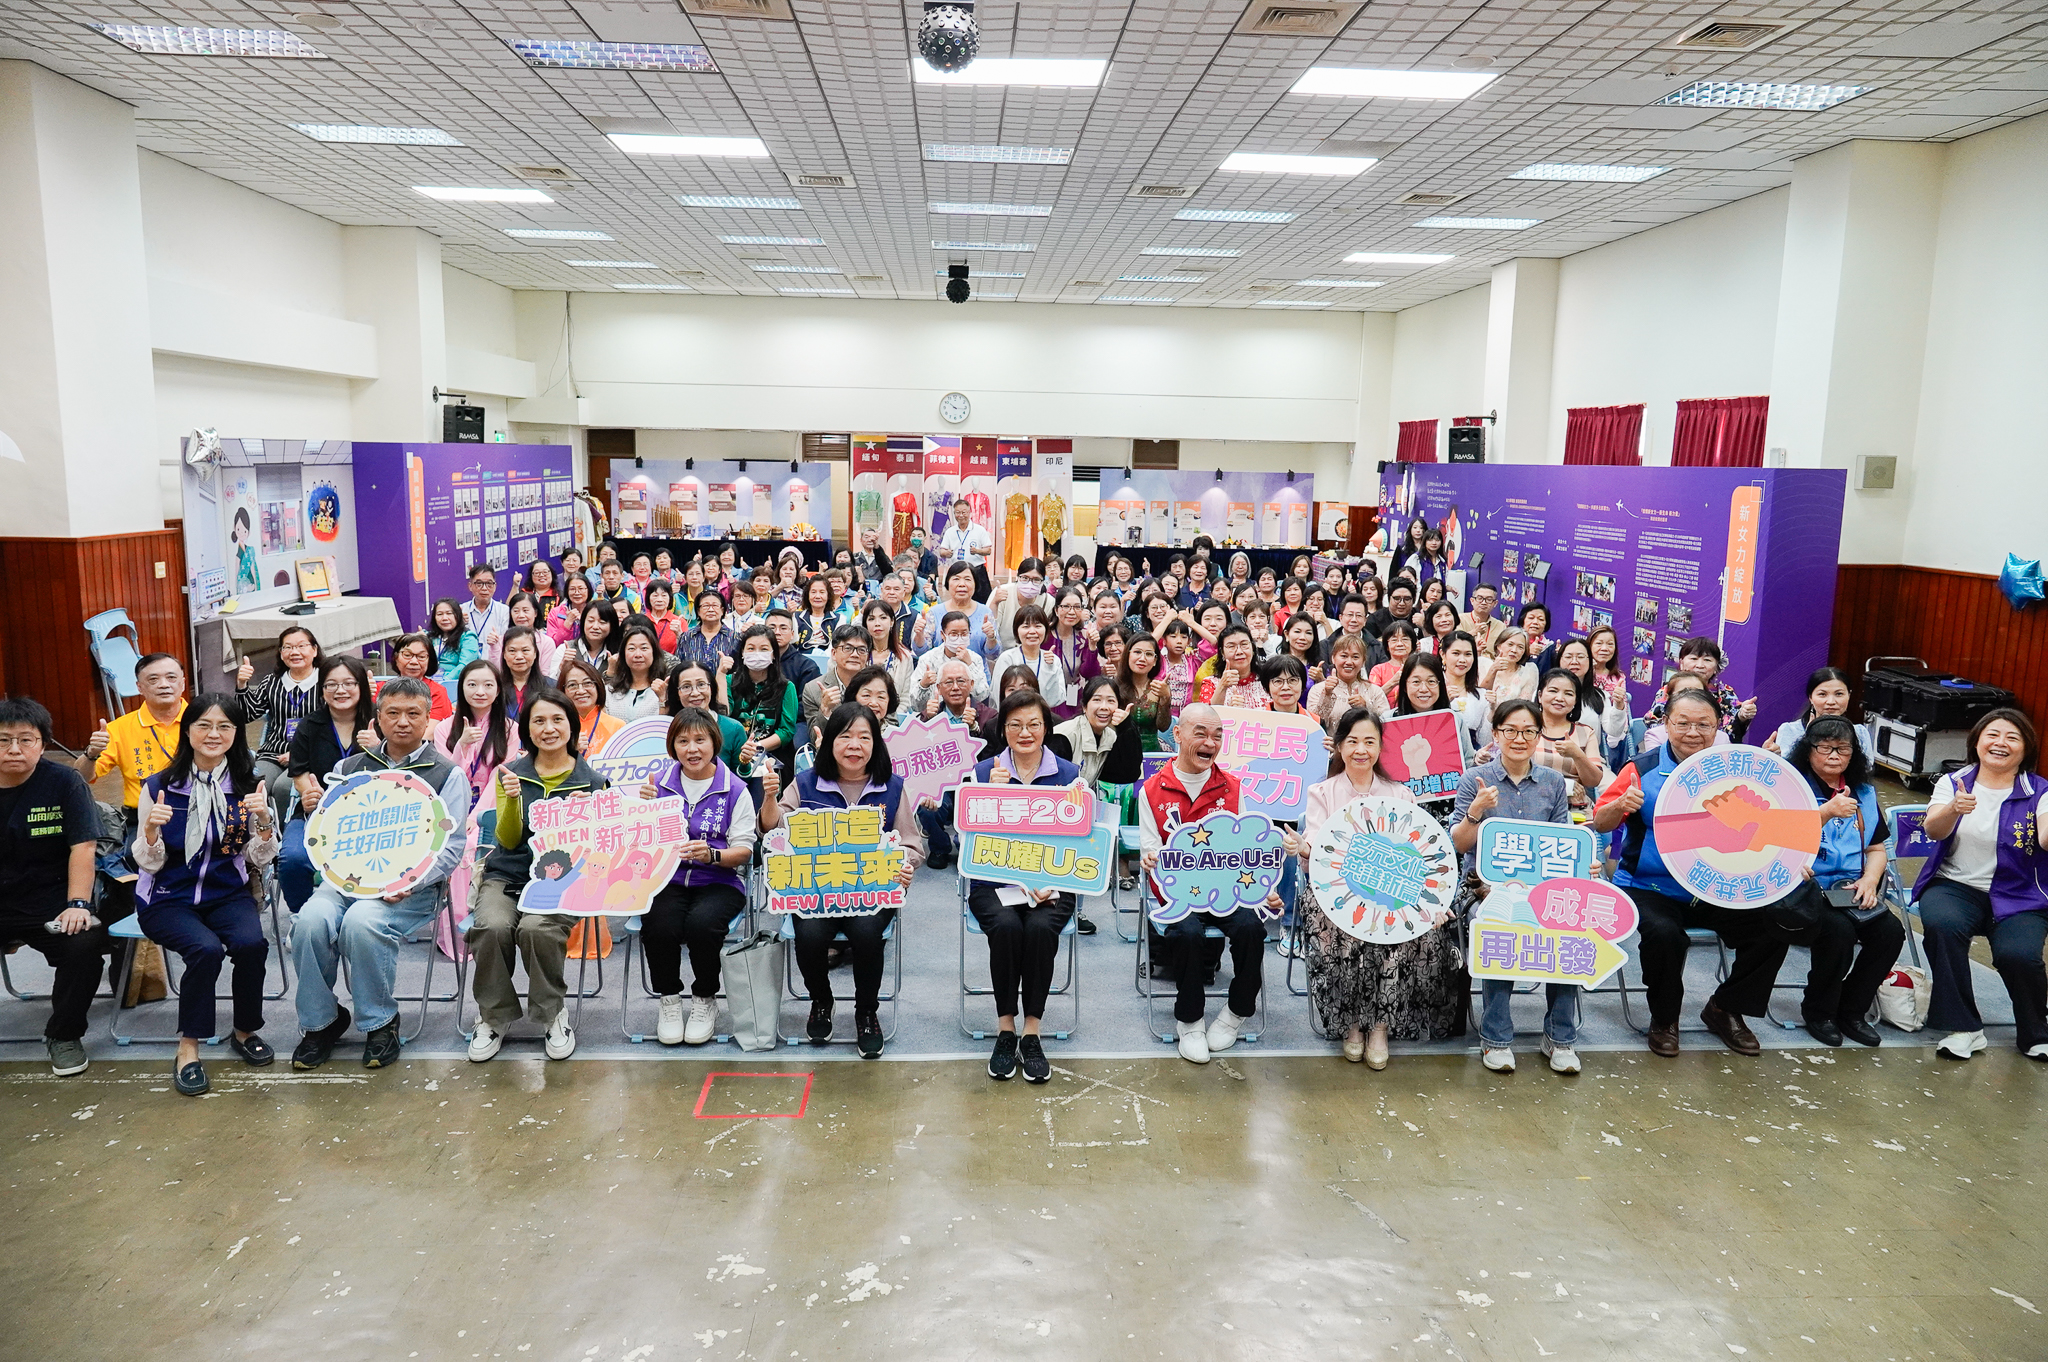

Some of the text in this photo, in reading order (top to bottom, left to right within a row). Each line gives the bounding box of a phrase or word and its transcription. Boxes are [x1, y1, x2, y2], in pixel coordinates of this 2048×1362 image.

[862, 453, 880, 462] 緬甸
[896, 453, 914, 463] 泰國
[929, 454, 955, 464] 菲律賓
[970, 456, 988, 465] 越南
[1046, 456, 1064, 466] 印尼
[1732, 505, 1750, 604] 新女力綻放
[1218, 763, 1302, 804] 女力
[1677, 750, 1782, 798] 友善新北
[337, 802, 422, 835] 在地關懷
[532, 792, 679, 830] 新女性 POWER
[788, 809, 882, 848] 創造
[968, 797, 1084, 825] 攜手20
[331, 825, 418, 860] 共好同行
[533, 815, 684, 854] WOMEN 新力量
[2012, 820, 2024, 848] 社會局
[767, 850, 904, 890] 新未來
[972, 834, 1100, 881] 閃耀Us
[1162, 848, 1282, 870] We Are Us!
[1350, 834, 1430, 883] 多元文化
[1491, 832, 1581, 879] 學習
[1338, 856, 1423, 906] 共譜新篇
[1686, 860, 1792, 900] 多元共融
[772, 890, 903, 910] NEW FUTURE
[1541, 888, 1618, 935] 成長
[1479, 930, 1596, 976] 再出發
